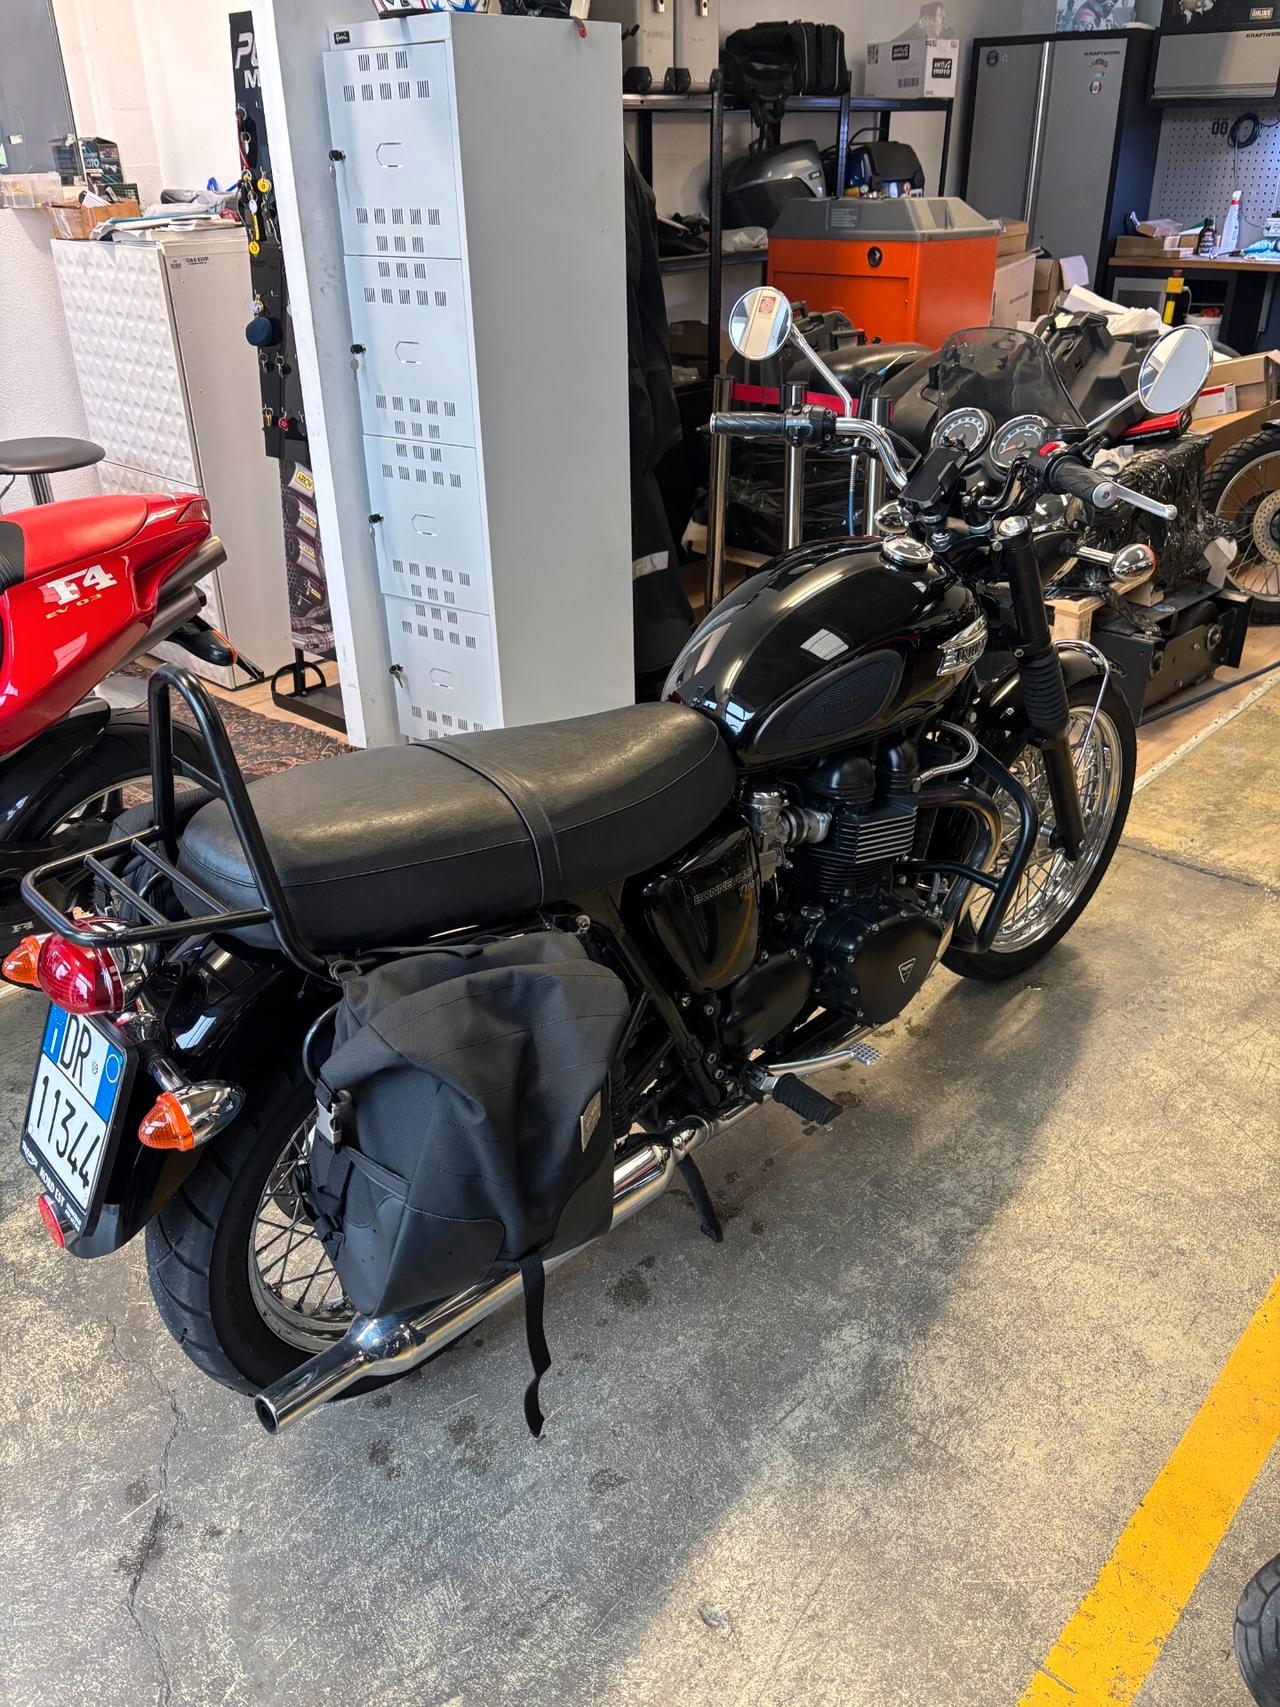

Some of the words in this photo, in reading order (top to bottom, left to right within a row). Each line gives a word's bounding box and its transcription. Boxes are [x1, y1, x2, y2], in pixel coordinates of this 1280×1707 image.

[46, 564, 118, 606] F4
[693, 865, 753, 906] BONNEVILLE
[60, 1014, 92, 1088] DR
[37, 1075, 101, 1190] 11344
